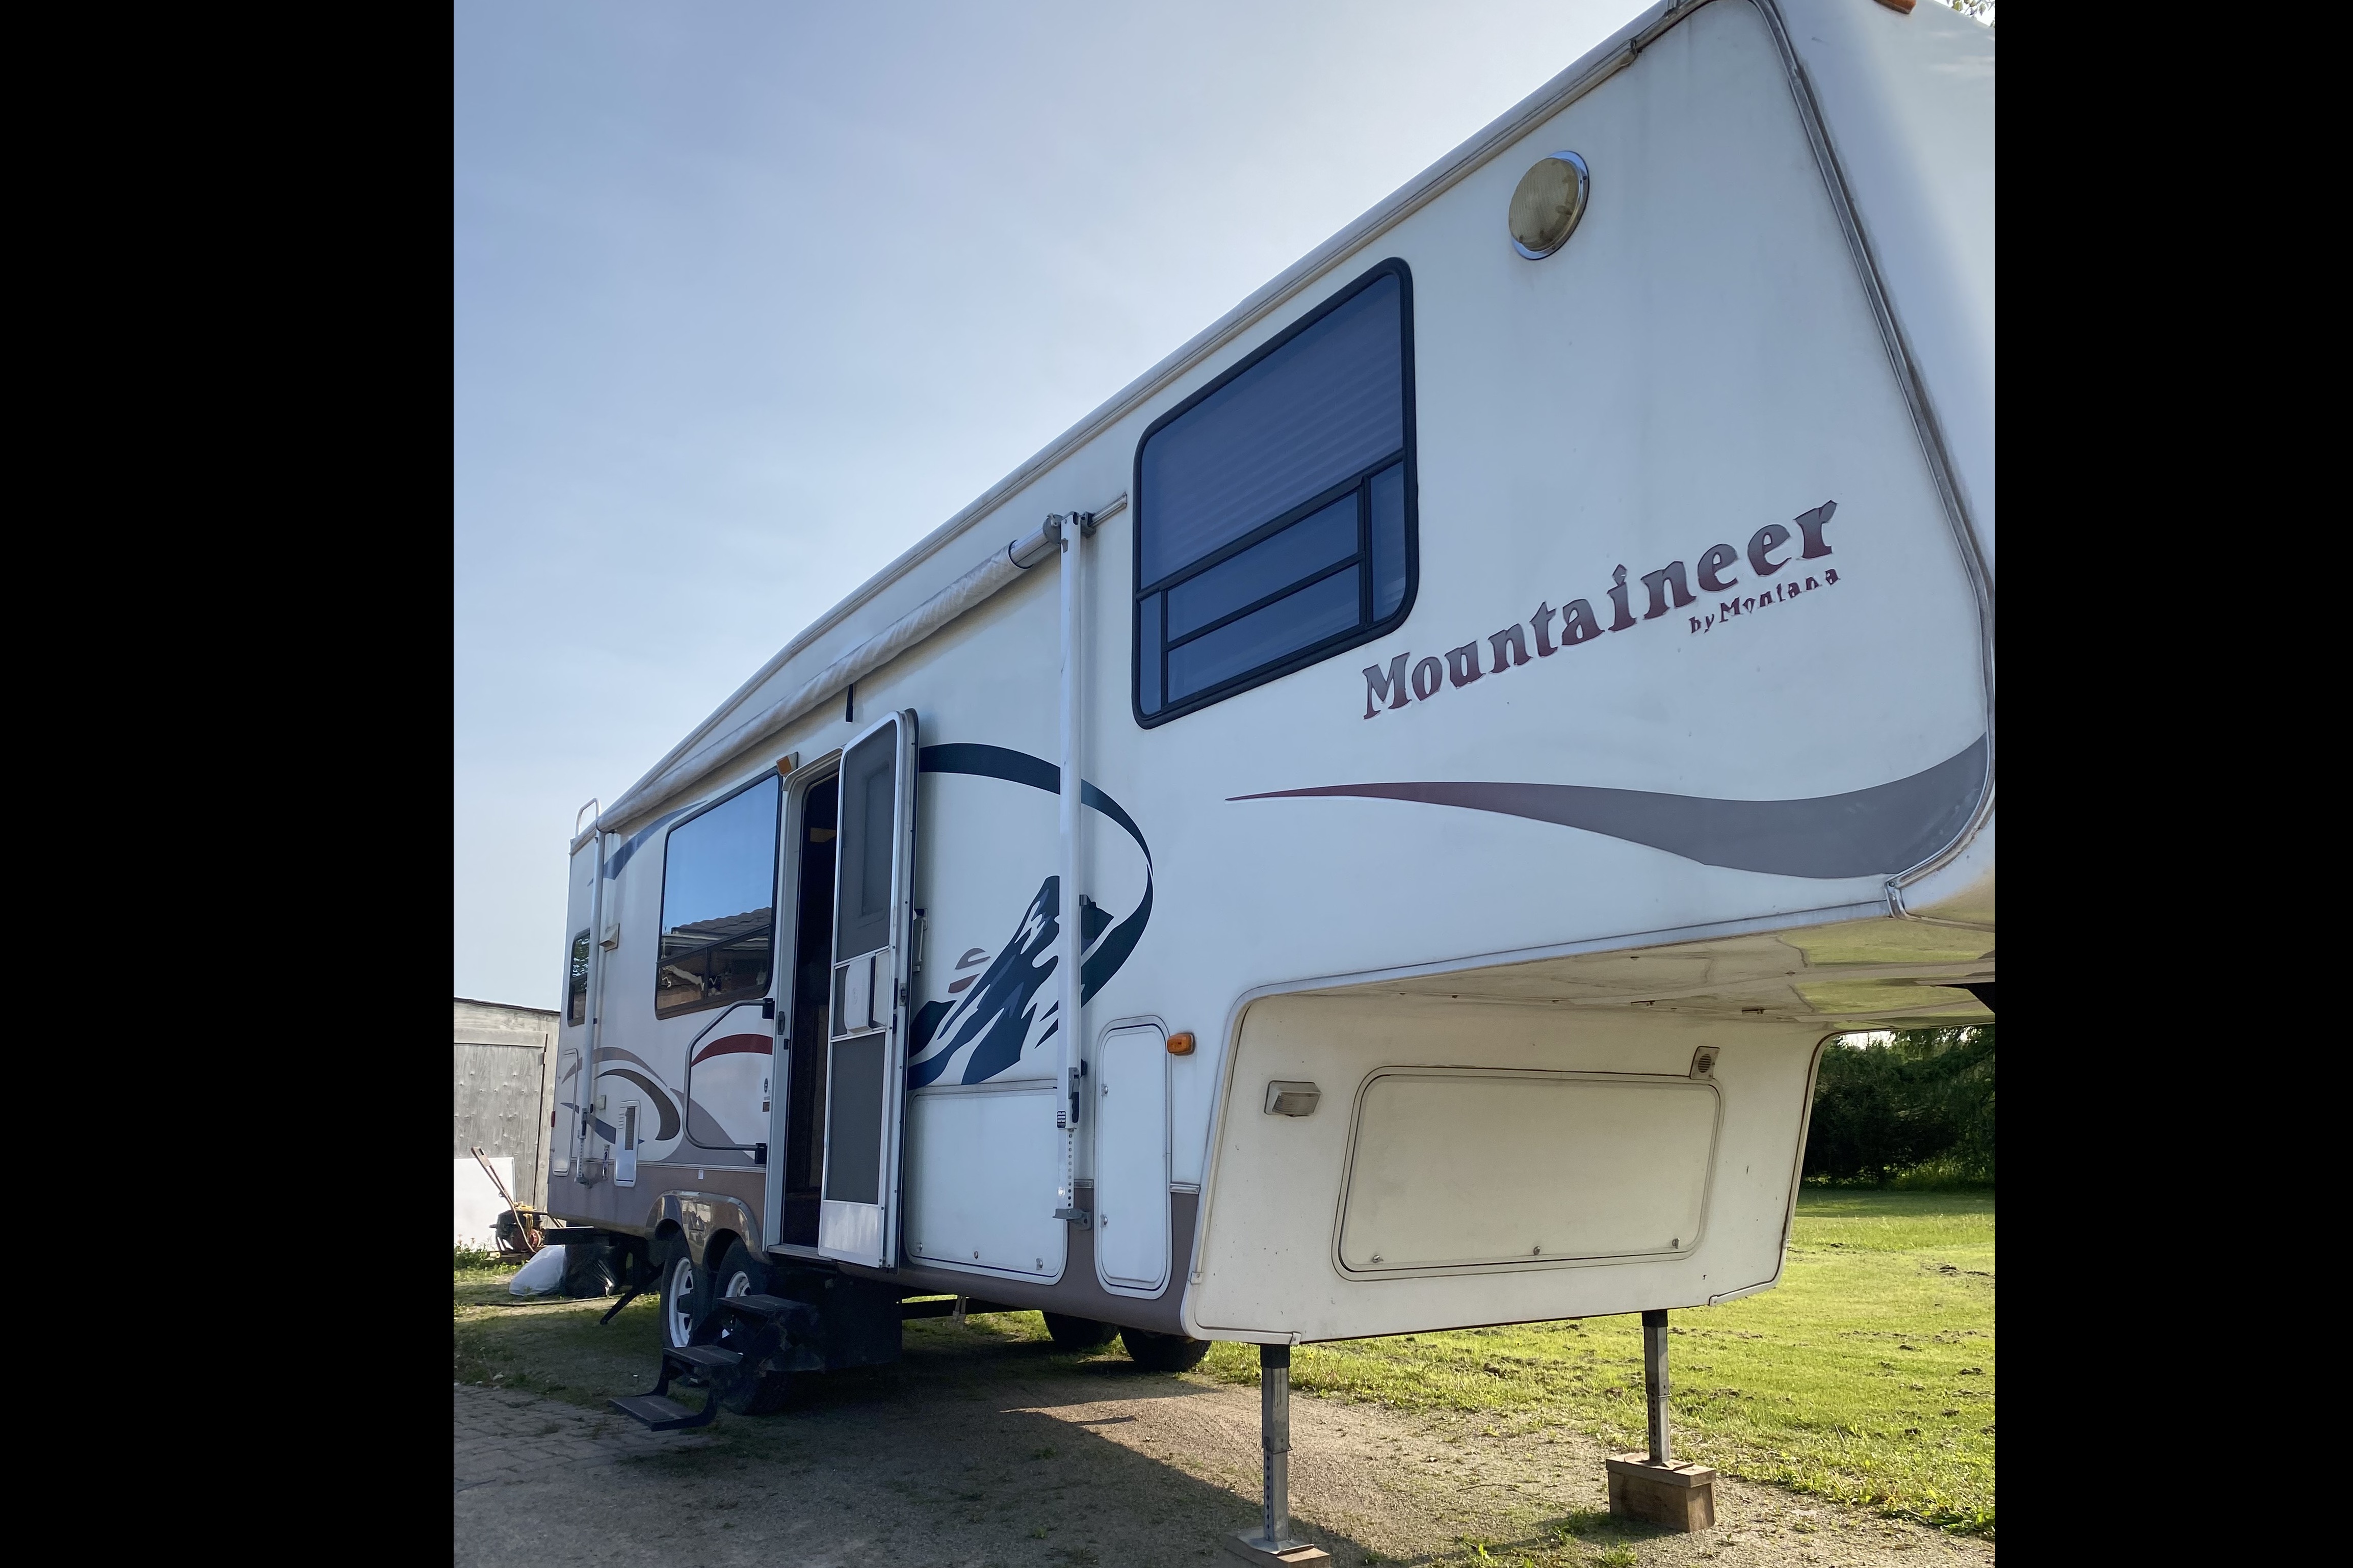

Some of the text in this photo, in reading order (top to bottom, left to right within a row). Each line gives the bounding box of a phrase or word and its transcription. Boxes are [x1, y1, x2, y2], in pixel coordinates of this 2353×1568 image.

[1362, 500, 1837, 720] Mountaineer
[1689, 568, 1841, 634] by Montana
